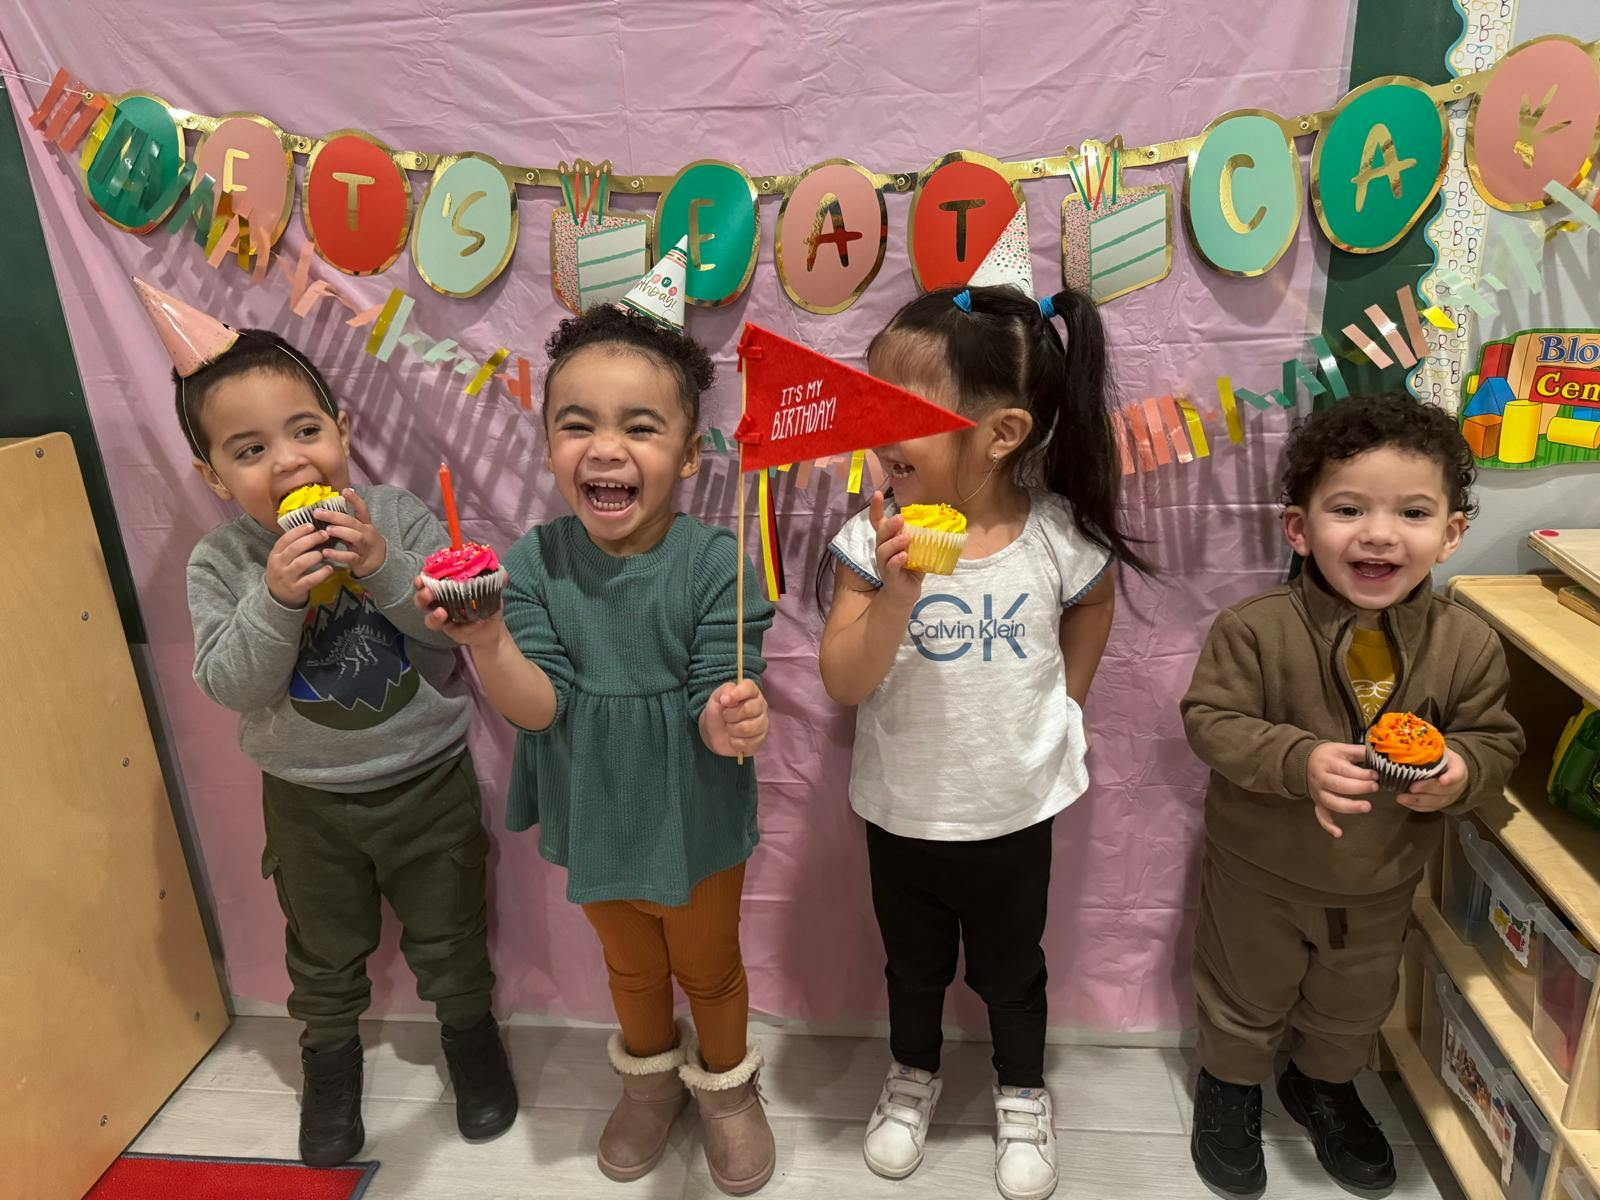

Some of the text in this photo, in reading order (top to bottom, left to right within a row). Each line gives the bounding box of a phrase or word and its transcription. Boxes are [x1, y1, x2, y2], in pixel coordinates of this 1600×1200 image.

[120, 83, 1573, 273] ET'S EAT CAK
[780, 379, 823, 407] IT'S MY
[1536, 372, 1600, 402] Cen
[771, 396, 837, 441] BIRTHDAY!
[907, 618, 1026, 640] Calvin Klein
[908, 593, 1030, 662] CK
